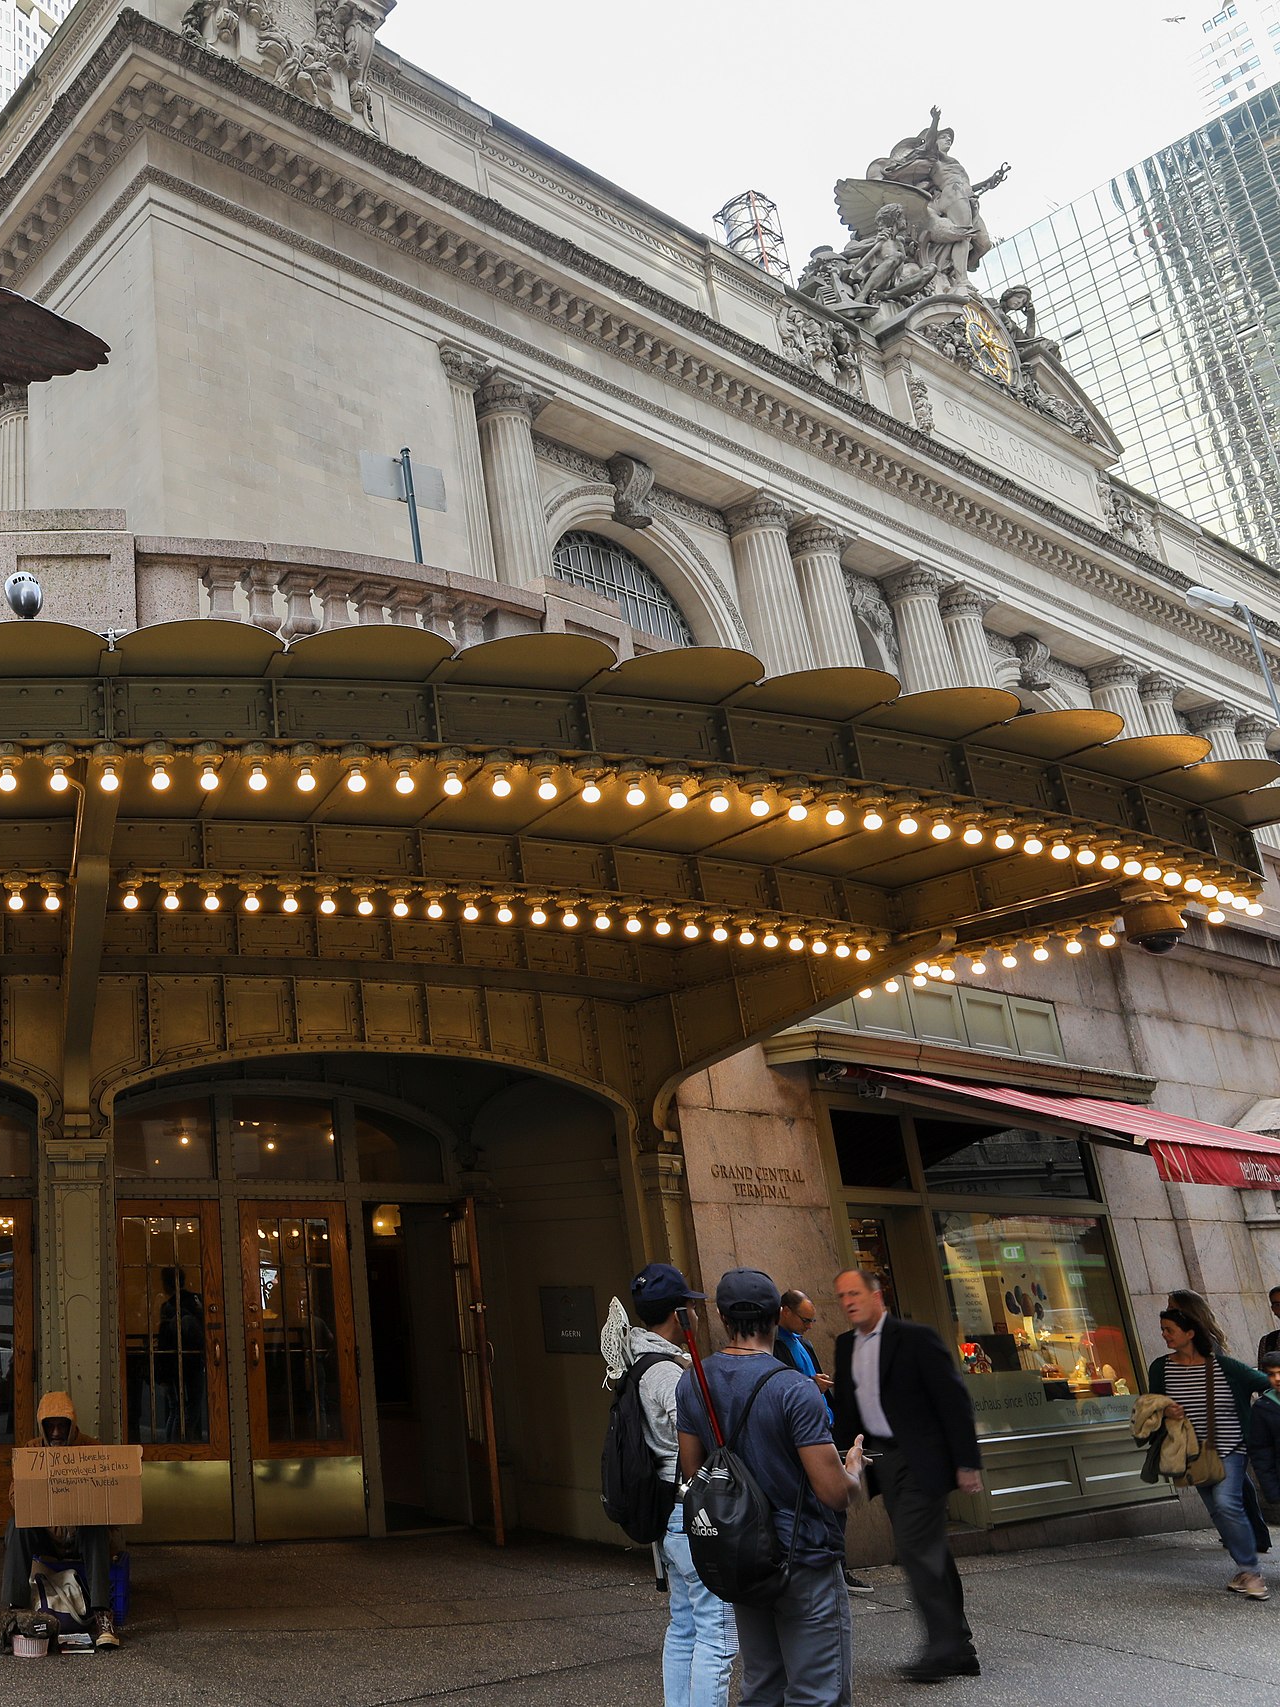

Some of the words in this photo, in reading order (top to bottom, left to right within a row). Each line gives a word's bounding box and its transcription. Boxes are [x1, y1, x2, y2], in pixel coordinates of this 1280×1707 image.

[944, 400, 999, 441] GRAND
[1009, 437, 1076, 486] CENTRAL
[978, 434, 1055, 488] TERMINAL
[711, 1164, 753, 1180] GRAND
[755, 1166, 805, 1183] CENTRAL
[1239, 1156, 1272, 1182] neuhaus
[732, 1183, 790, 1199] TERMINAL
[1004, 1394, 1023, 1409] since
[1025, 1391, 1043, 1407] 1857
[27, 1451, 45, 1471] 79
[63, 1452, 75, 1464] Old
[691, 1525, 718, 1537] adidas
